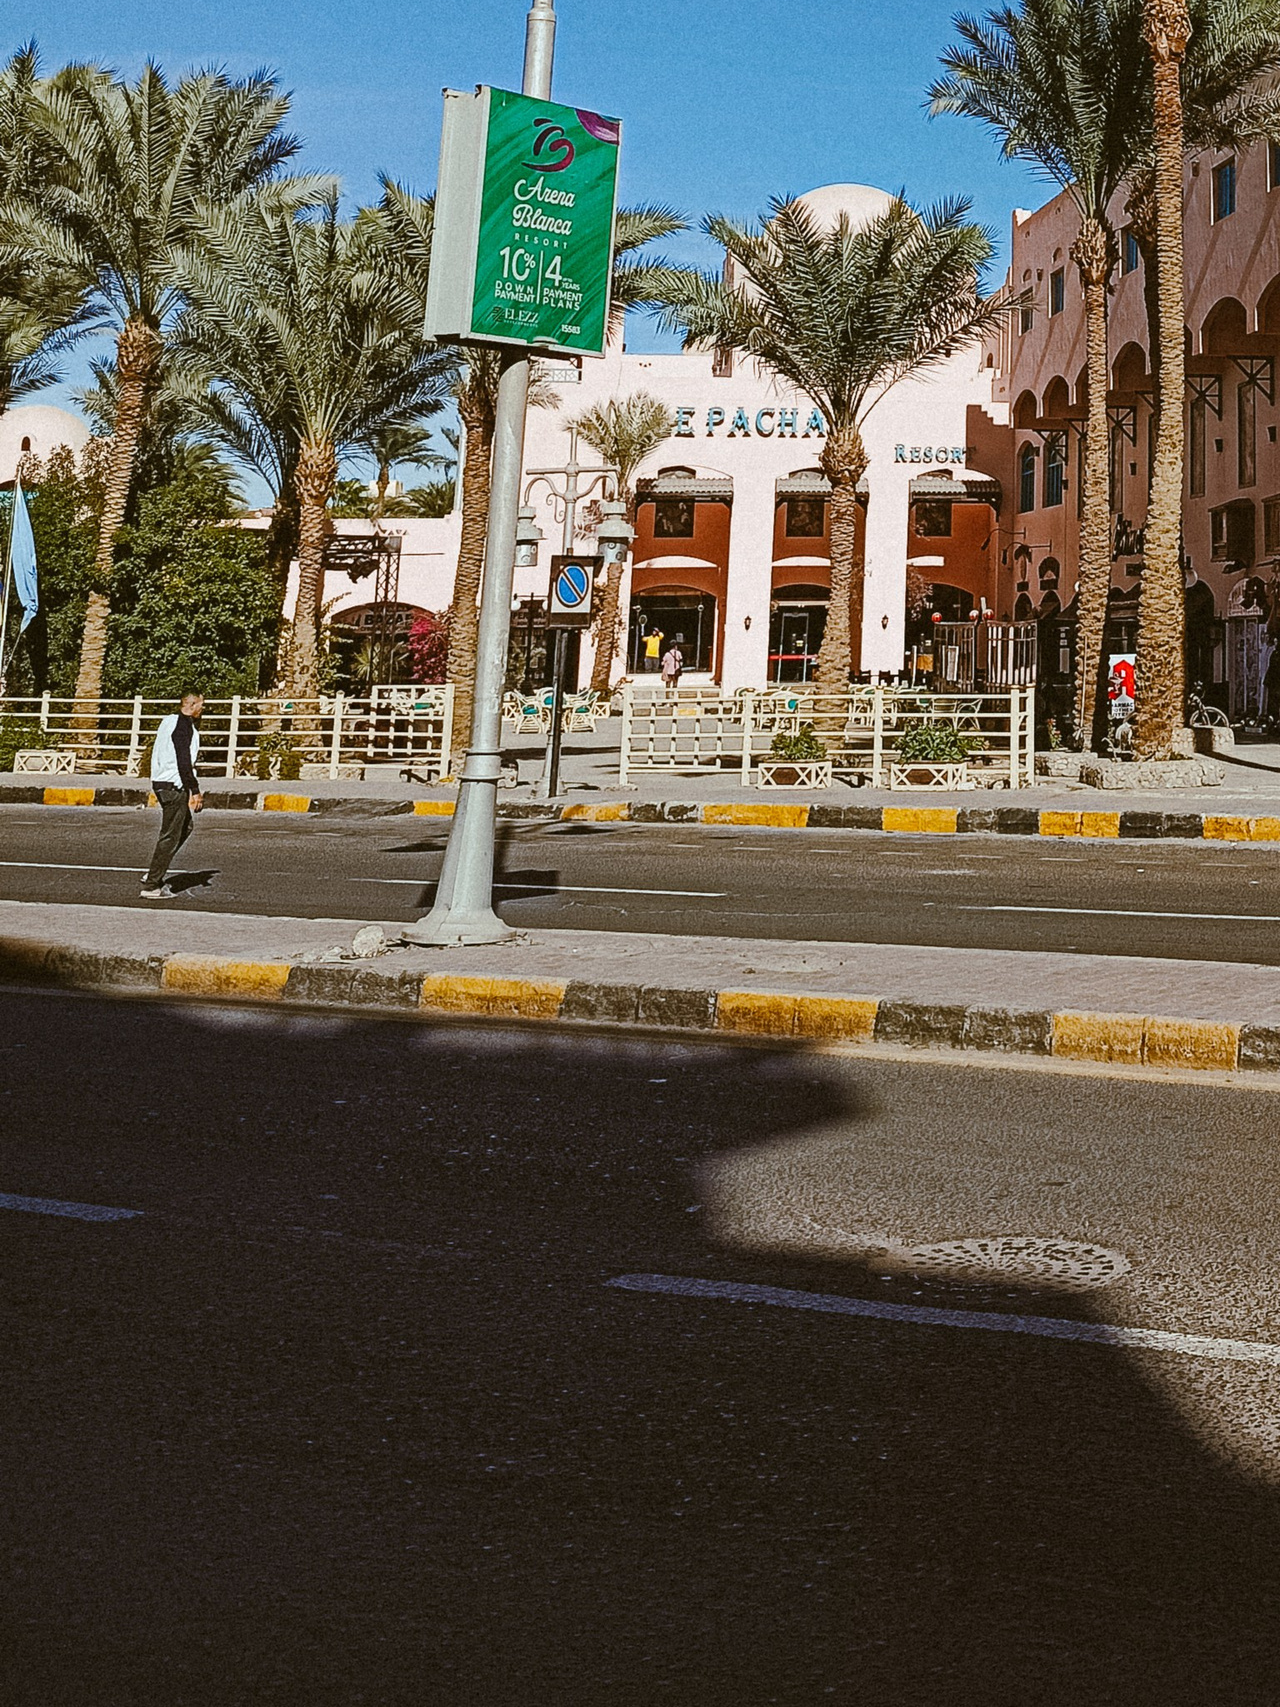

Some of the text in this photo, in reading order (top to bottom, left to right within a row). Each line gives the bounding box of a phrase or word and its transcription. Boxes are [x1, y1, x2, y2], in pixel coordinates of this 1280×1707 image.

[514, 175, 576, 208] Arena
[512, 203, 573, 236] Blanca
[514, 232, 568, 250] RESORT
[499, 246, 536, 282] 10%
[544, 255, 562, 287] 4
[495, 280, 534, 295] DOWN
[543, 287, 583, 302] PAYMENT
[561, 282, 581, 291] YEARS
[494, 289, 536, 304] PAYMENT
[542, 296, 581, 311] PLANS
[676, 406, 826, 436] E PACHA
